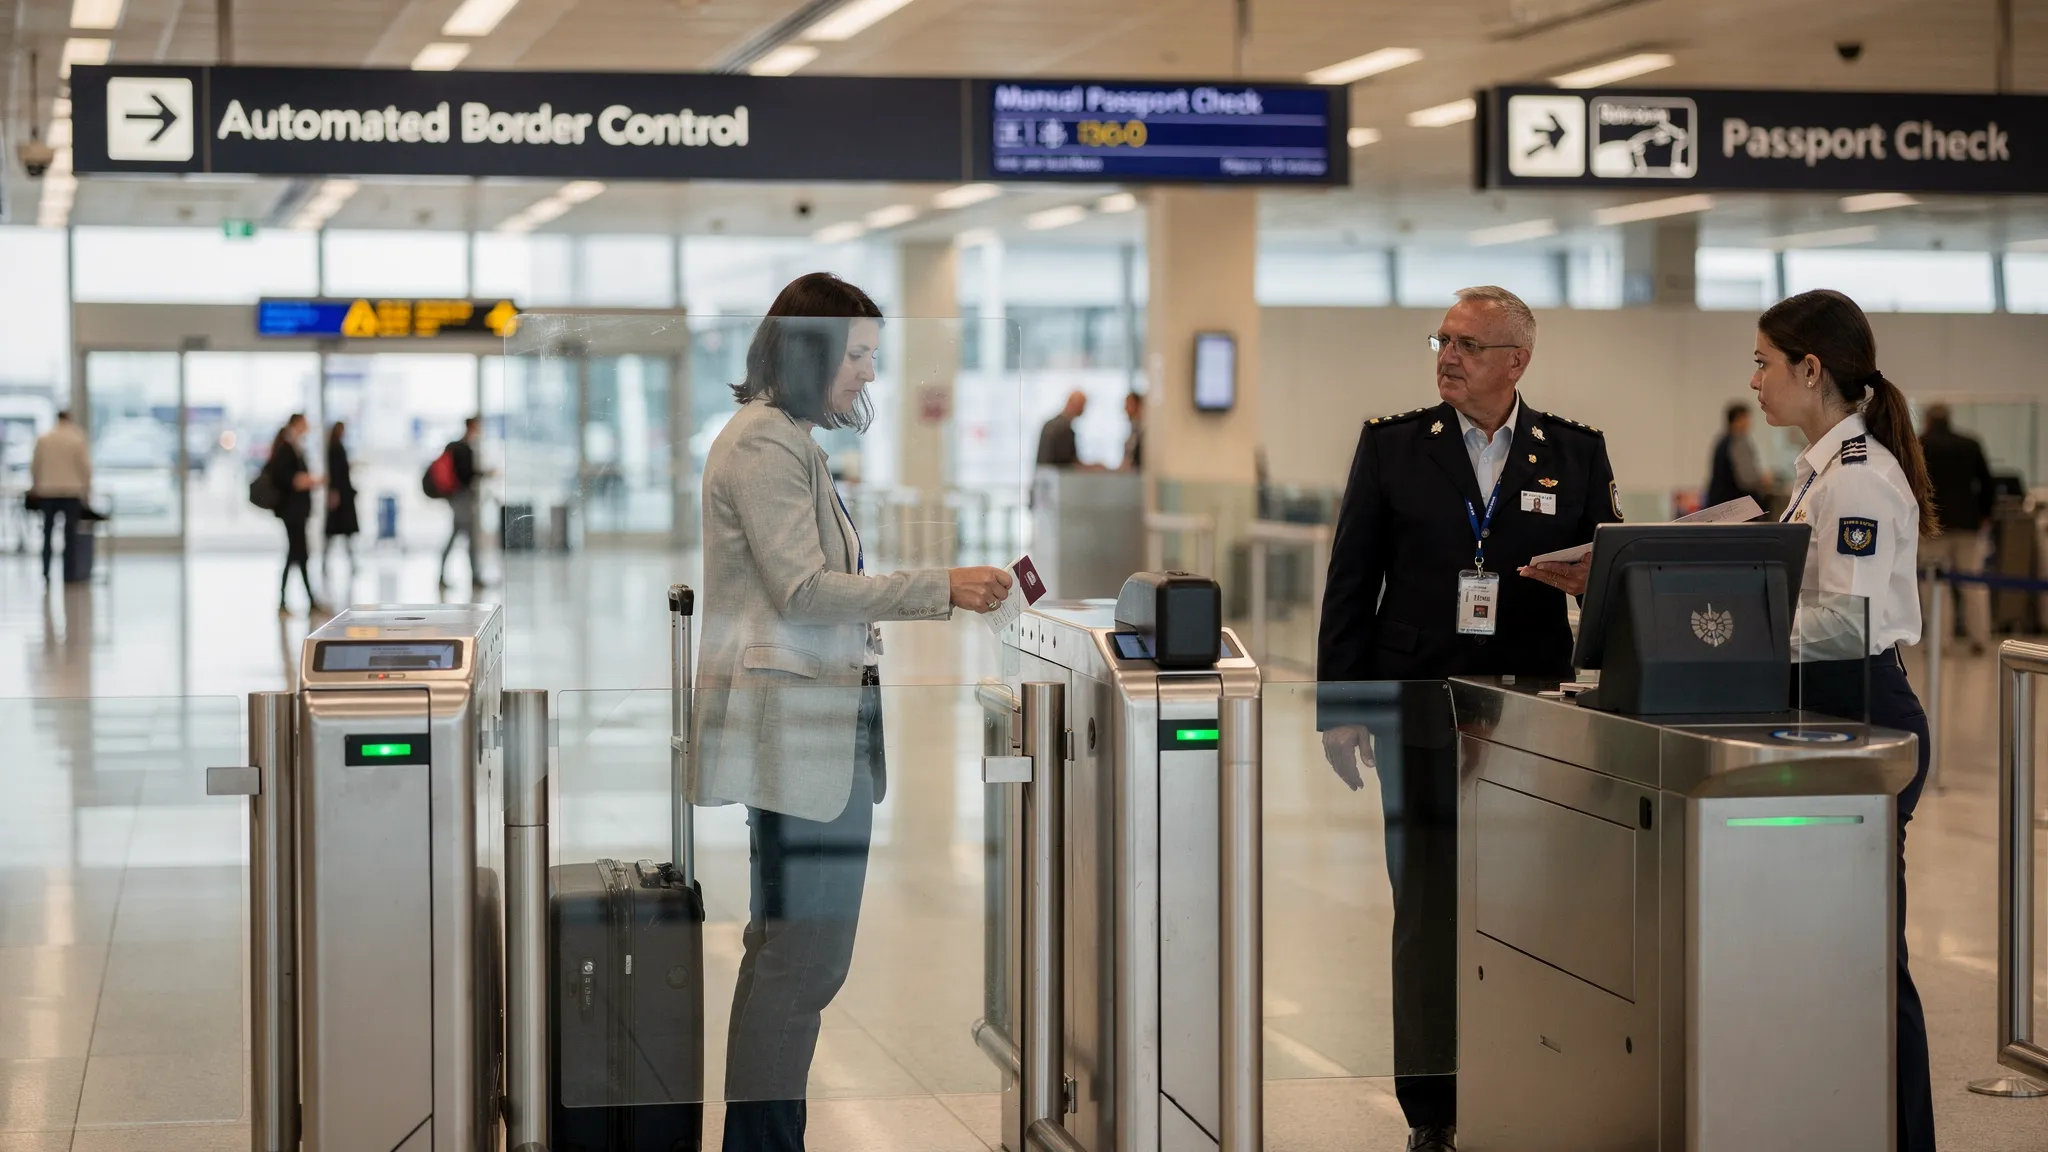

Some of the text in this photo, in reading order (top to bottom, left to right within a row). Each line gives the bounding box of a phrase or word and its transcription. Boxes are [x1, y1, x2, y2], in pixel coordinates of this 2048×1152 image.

[217, 99, 749, 147] Automated Border Control
[1721, 117, 2010, 167] Passport Check
